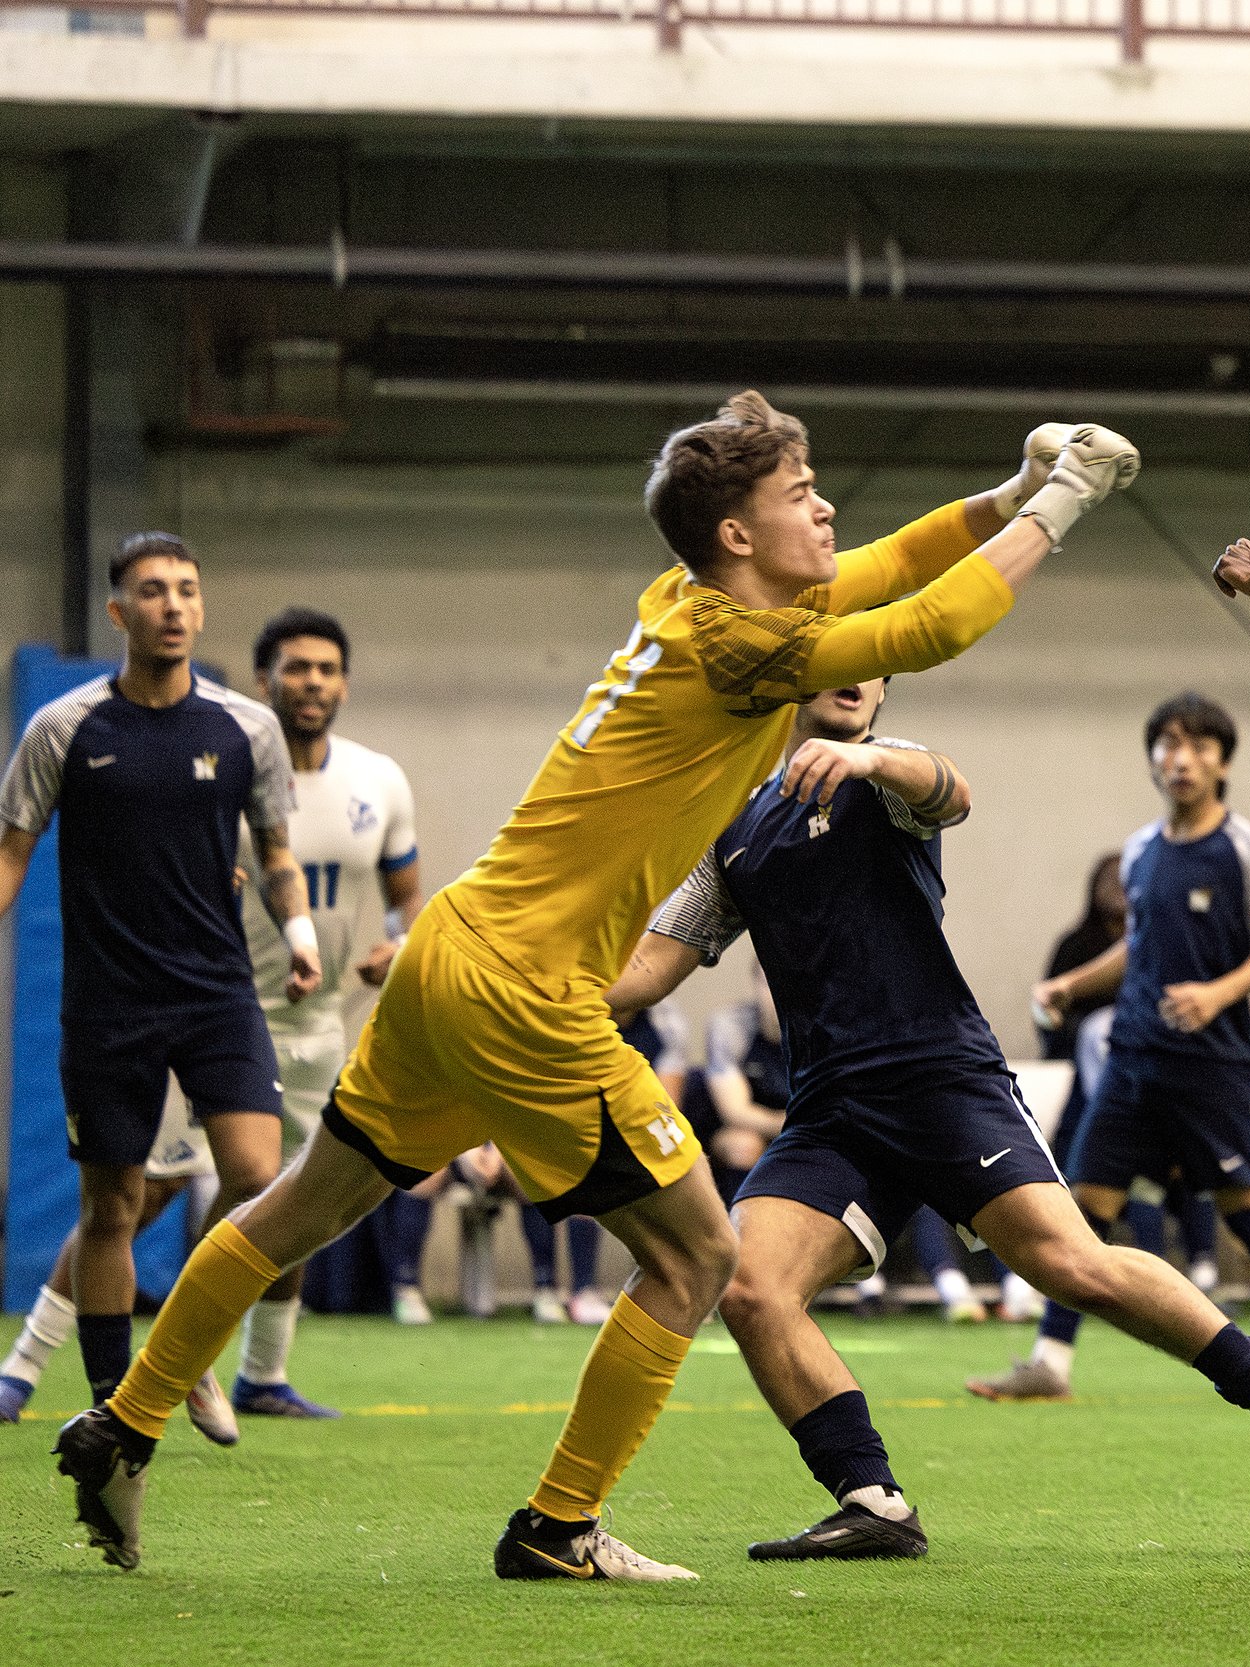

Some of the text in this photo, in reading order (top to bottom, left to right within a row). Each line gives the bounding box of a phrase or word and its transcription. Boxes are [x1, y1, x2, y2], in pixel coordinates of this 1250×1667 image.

[808, 813, 830, 839] H
[303, 861, 341, 910] 11
[645, 1113, 686, 1157] H
